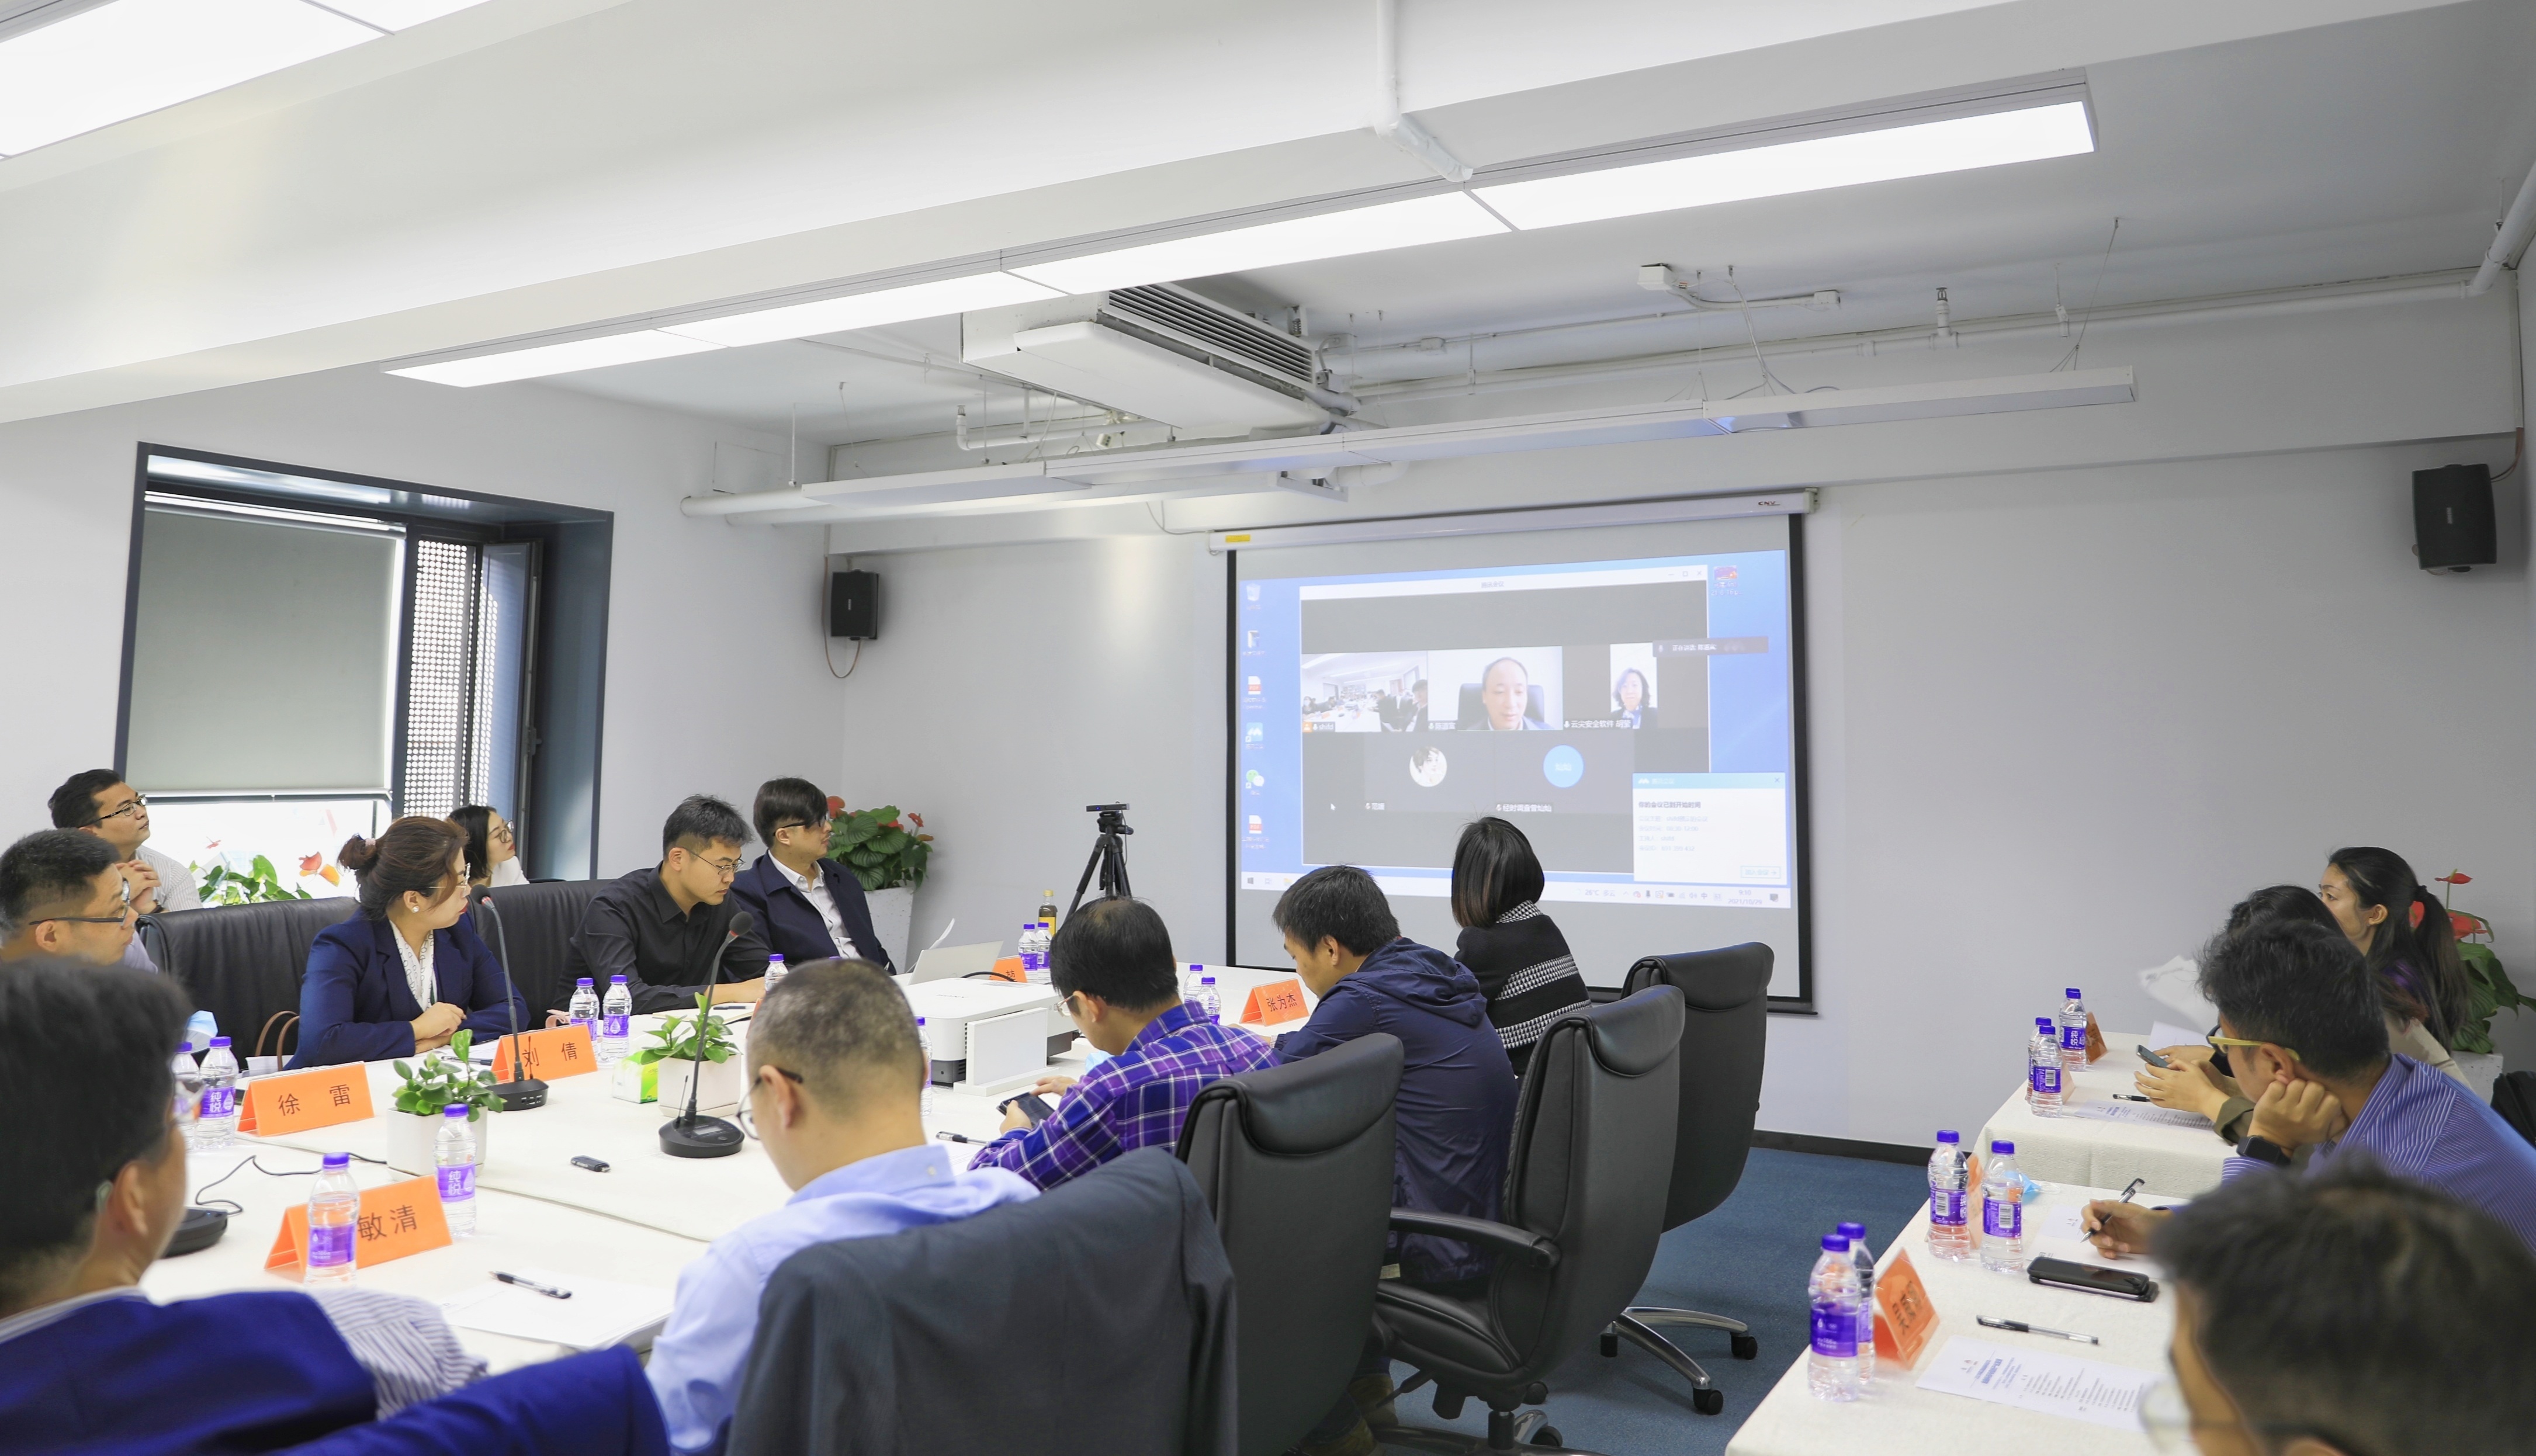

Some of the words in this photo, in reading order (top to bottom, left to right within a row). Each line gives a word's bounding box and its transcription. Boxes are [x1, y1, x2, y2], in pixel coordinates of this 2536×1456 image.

[1266, 993, 1297, 1012] 张为杰
[210, 1091, 223, 1112] 纯悦
[448, 1170, 462, 1195] 纯悦
[357, 1204, 417, 1241] 敏清
